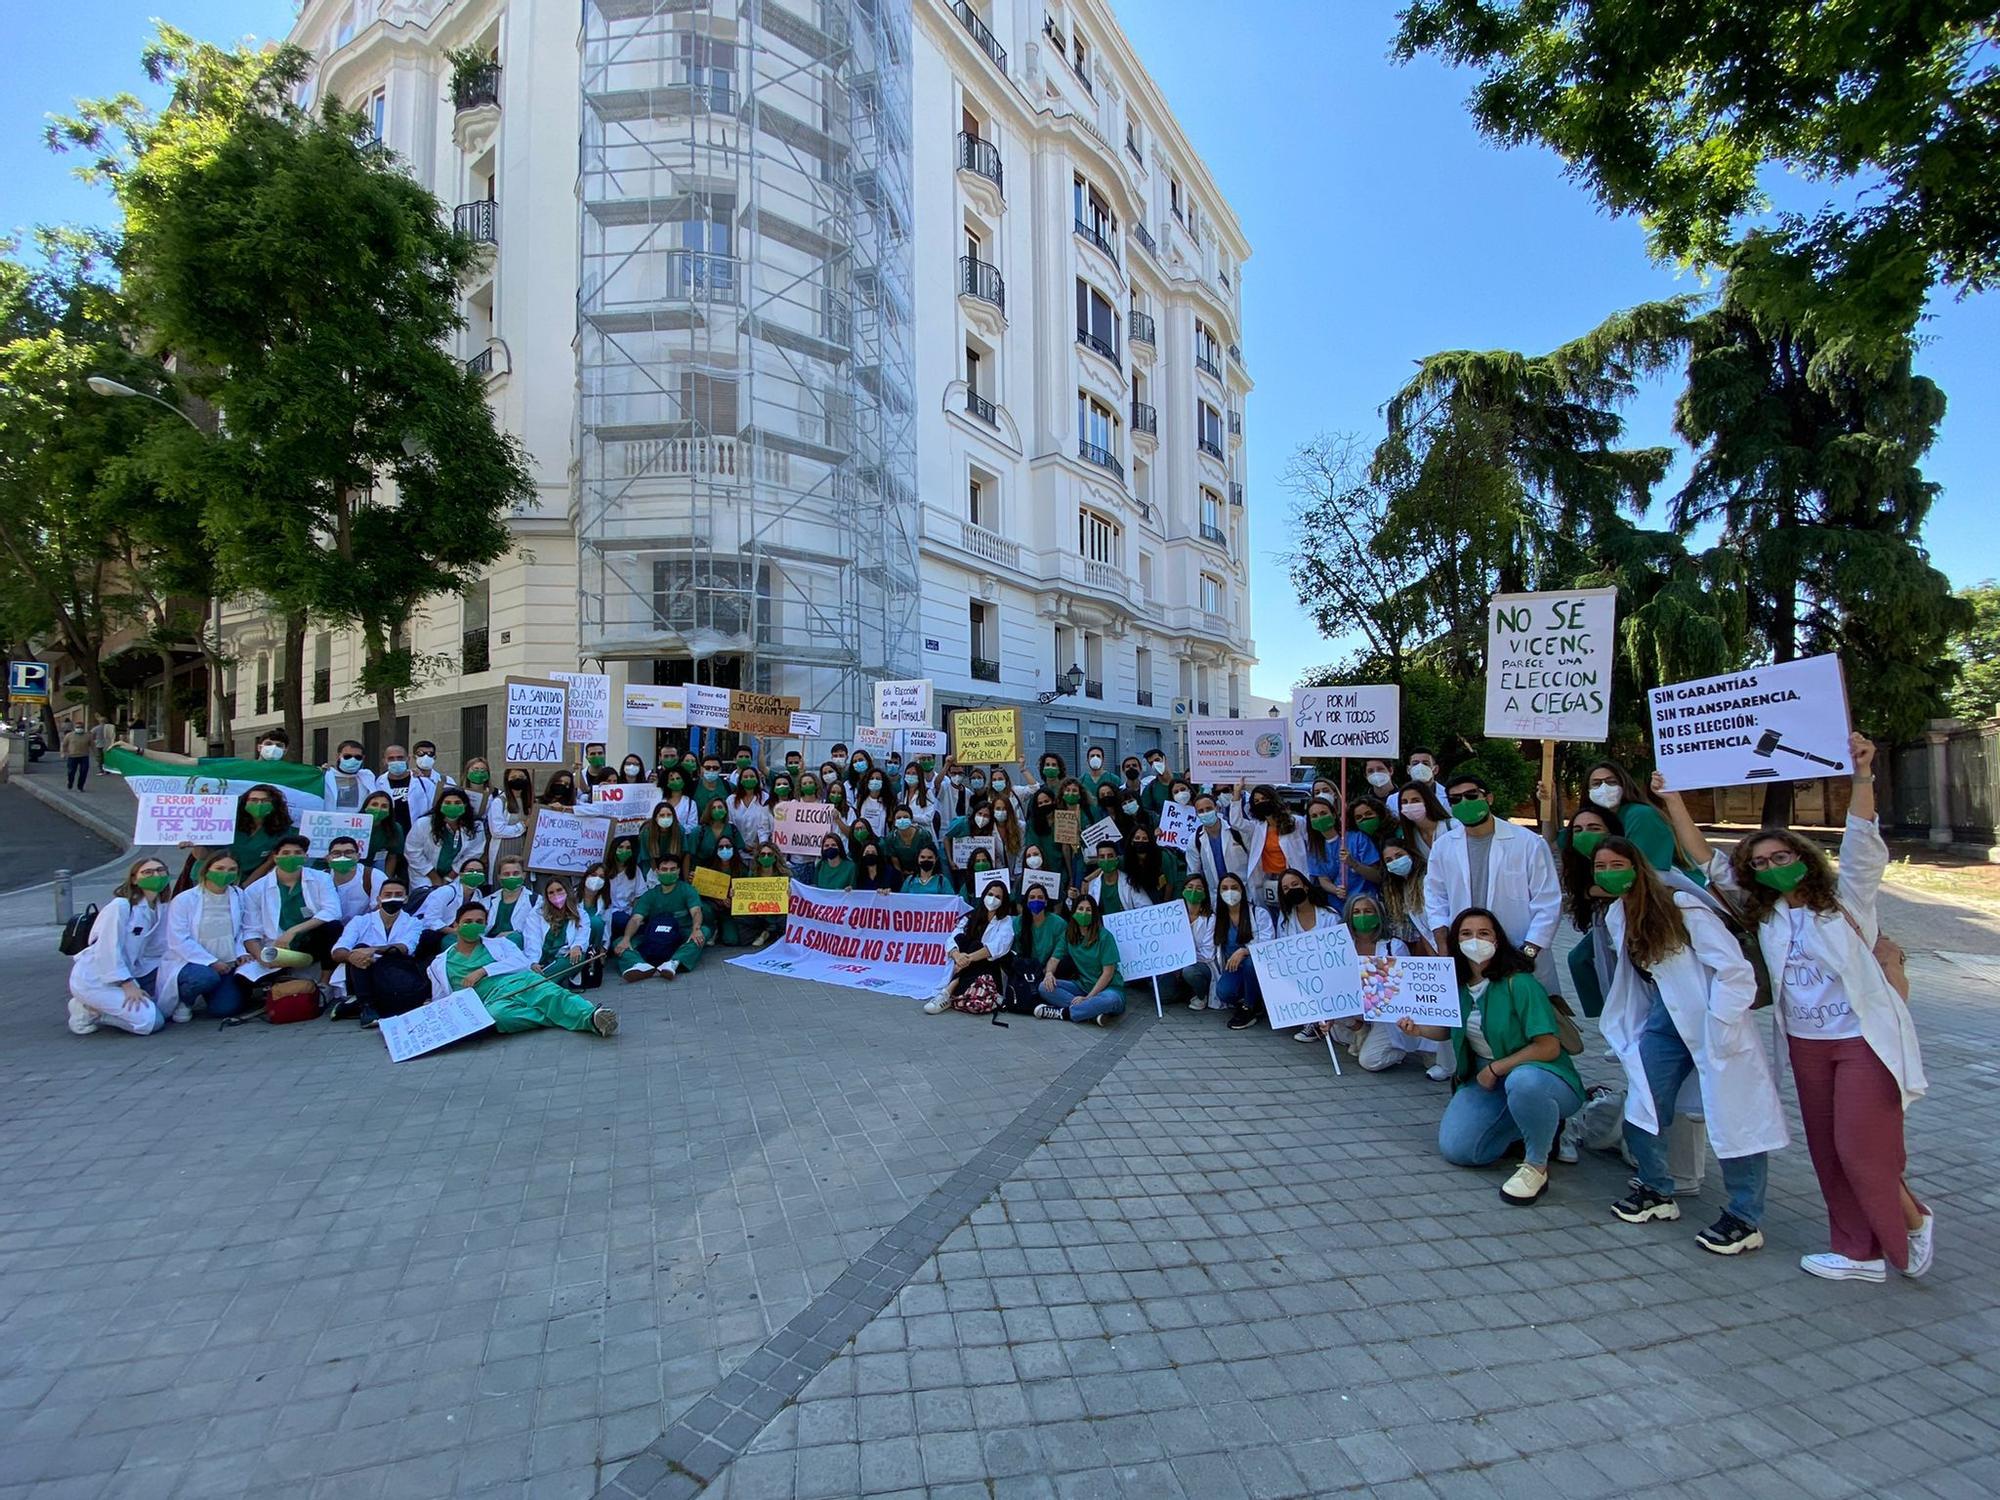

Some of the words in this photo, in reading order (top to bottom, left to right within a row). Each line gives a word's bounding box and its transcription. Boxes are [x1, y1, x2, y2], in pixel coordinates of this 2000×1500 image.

[1496, 606, 1532, 634] NO
[1502, 658, 1544, 669] PARECE
[1558, 657, 1583, 666] UNA
[13, 664, 45, 688] P
[1500, 670, 1597, 690] ELECCION
[511, 688, 526, 701] LA
[529, 689, 563, 703] SANIDAD
[1654, 690, 1674, 704] SIN
[1677, 675, 1758, 700] GARANTÍAS
[1326, 694, 1343, 708] POR
[1504, 696, 1519, 713] A
[1531, 690, 1604, 715] CIEGAS
[509, 704, 562, 715] ESPECIALIZADA
[1314, 711, 1322, 723] Y
[1326, 711, 1342, 723] POR
[1345, 710, 1376, 723] TODOS
[1657, 708, 1677, 722] SIN
[509, 718, 521, 728] NO
[523, 718, 533, 728] SE
[533, 718, 560, 728] MERECE
[958, 714, 971, 726] SIN
[1512, 717, 1569, 733] #FSE
[1658, 725, 1675, 740] NO
[1677, 723, 1691, 738] ES
[1694, 713, 1759, 735] ELECCIÓN:
[521, 729, 545, 740] ESTA
[1304, 730, 1329, 747] MIR
[1330, 729, 1390, 746] COMPAÑEROS
[507, 740, 558, 760] CAGADA
[1660, 742, 1674, 756] ES
[1676, 735, 1752, 755] SENTENCIA
[157, 795, 195, 805] ERROR
[795, 805, 832, 825] ELECCIÓN
[1167, 806, 1181, 818] Por
[191, 819, 233, 832] JUSTA
[309, 815, 332, 826] LOS
[1170, 821, 1183, 829] por
[159, 832, 178, 841] Not
[1157, 831, 1178, 844] MIR
[788, 895, 848, 925] GOBIERNE
[848, 906, 890, 931] QUIEN
[1108, 904, 1183, 928] MERECEMOS
[785, 924, 802, 944] LA
[803, 929, 861, 959] SANIDAD
[861, 939, 884, 961] NO
[884, 940, 904, 963] SE
[1139, 940, 1159, 955] NO
[1256, 929, 1347, 961] MERECEMOS
[1401, 962, 1425, 971] POR
[1427, 963, 1441, 971] MI
[1443, 963, 1451, 972] Y
[1412, 972, 1436, 981] POR
[1297, 975, 1324, 996] NO
[1407, 983, 1447, 993] TODOS
[1415, 994, 1438, 1003] MIR
[1380, 1004, 1459, 1018] COMPAÑEROS
[1793, 1002, 1849, 1028] asignac
